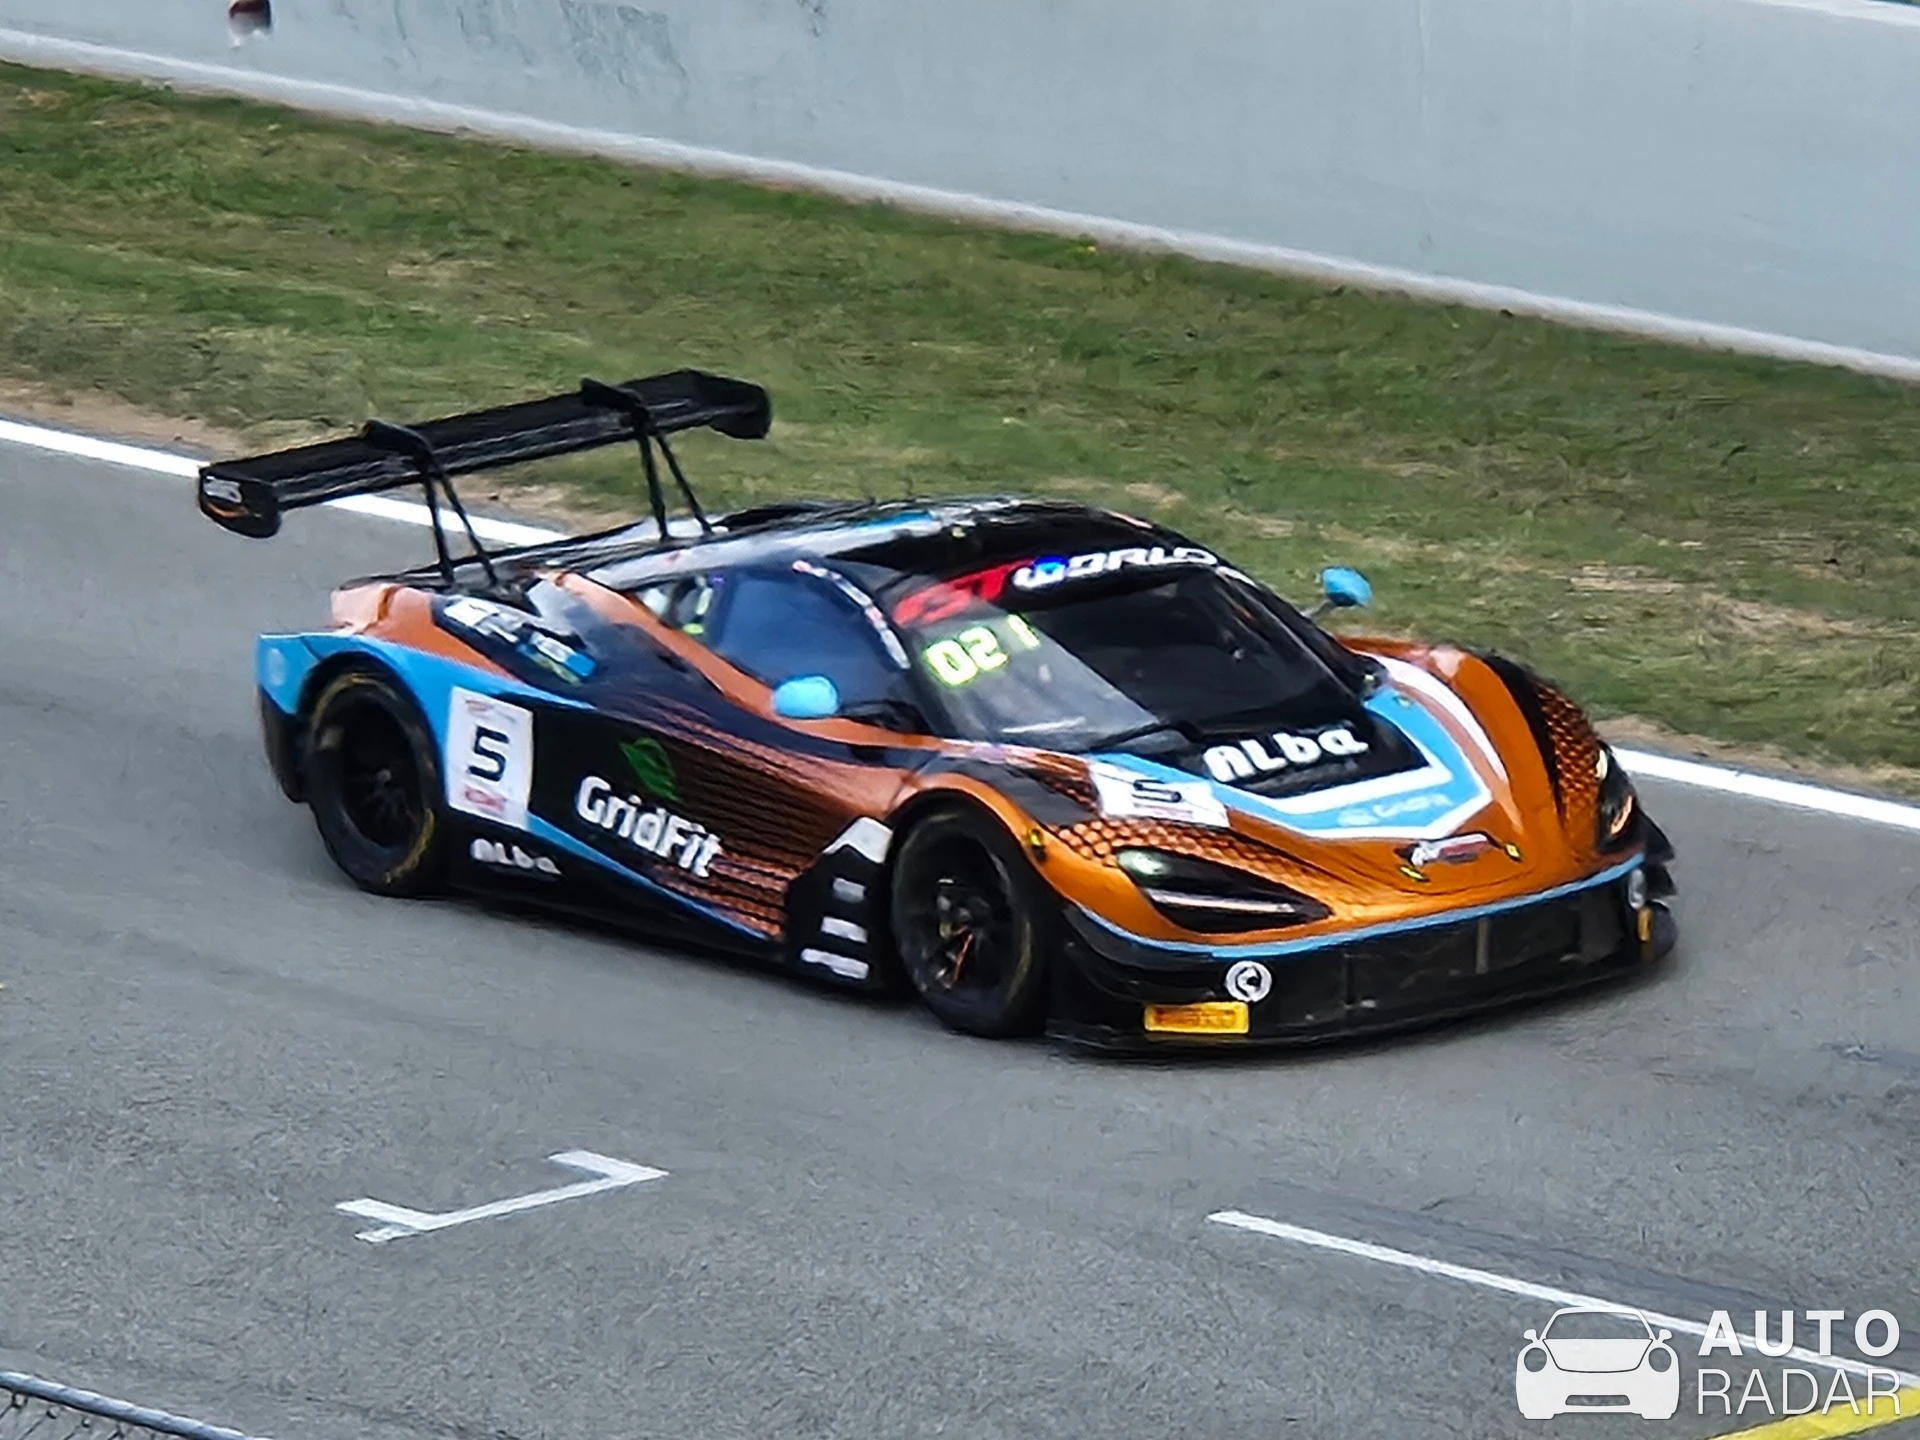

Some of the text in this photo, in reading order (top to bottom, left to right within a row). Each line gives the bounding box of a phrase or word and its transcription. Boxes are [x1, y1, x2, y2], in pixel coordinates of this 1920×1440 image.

[892, 557, 1033, 628] GT
[1011, 546, 1219, 590] WORLD
[467, 725, 510, 783] 5
[1131, 778, 1183, 804] 5
[577, 775, 723, 878] GridFit
